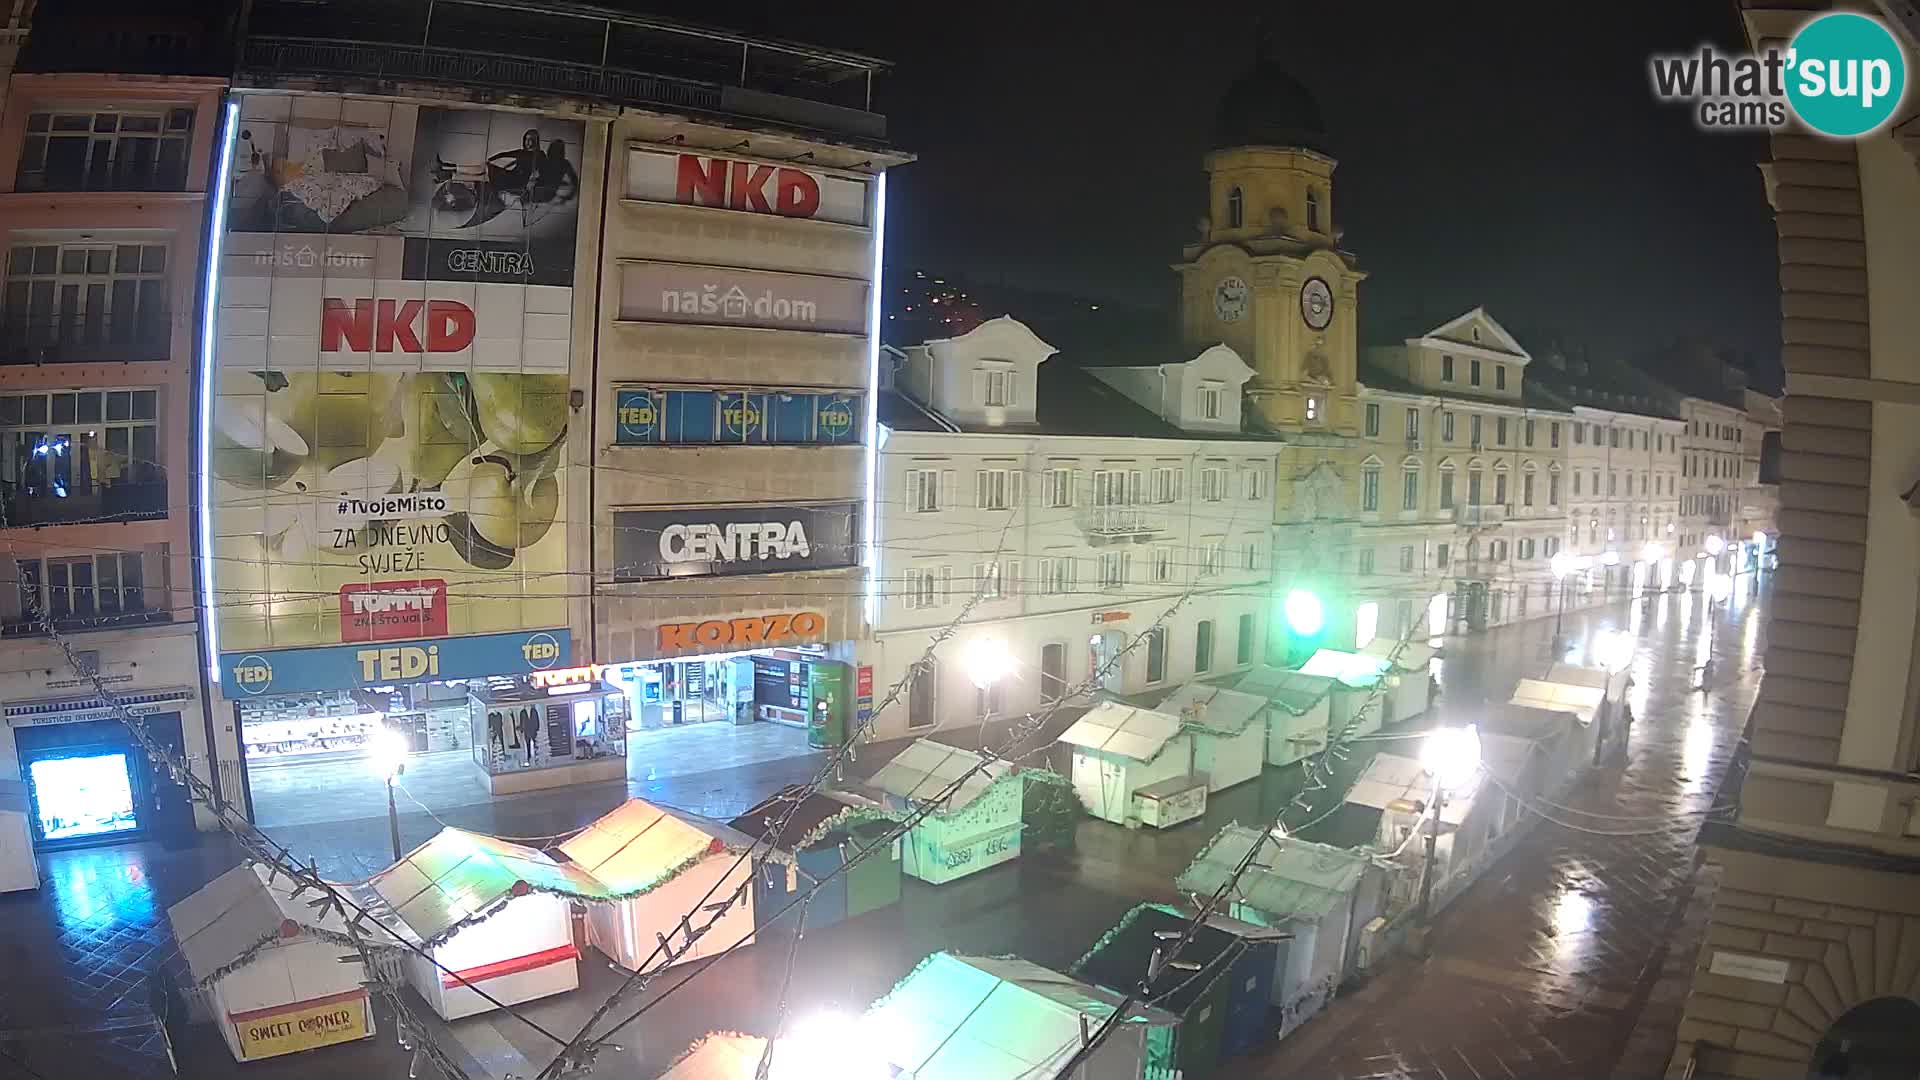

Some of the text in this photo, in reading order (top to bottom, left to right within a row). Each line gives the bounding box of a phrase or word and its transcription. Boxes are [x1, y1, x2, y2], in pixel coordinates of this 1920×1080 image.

[676, 154, 820, 217] NKD
[321, 246, 367, 267] dom
[448, 249, 534, 275] CENTRA
[661, 284, 816, 321] naš dom
[320, 298, 477, 354] NKD
[618, 407, 657, 425] TEDi
[723, 408, 760, 426] TEDi
[338, 497, 446, 516] #TvojeMisto
[333, 523, 450, 548] ZA DNEVNO
[659, 520, 810, 563] CENTRA
[359, 547, 425, 575] SVJEŽE
[348, 586, 440, 614] TOMMY
[659, 612, 825, 649] KORZO
[357, 645, 439, 682] TEDi
[521, 642, 560, 660] TEDi
[232, 665, 273, 684] TEDi
[249, 1021, 292, 1041] SWEET
[298, 1010, 351, 1033] CORNER
